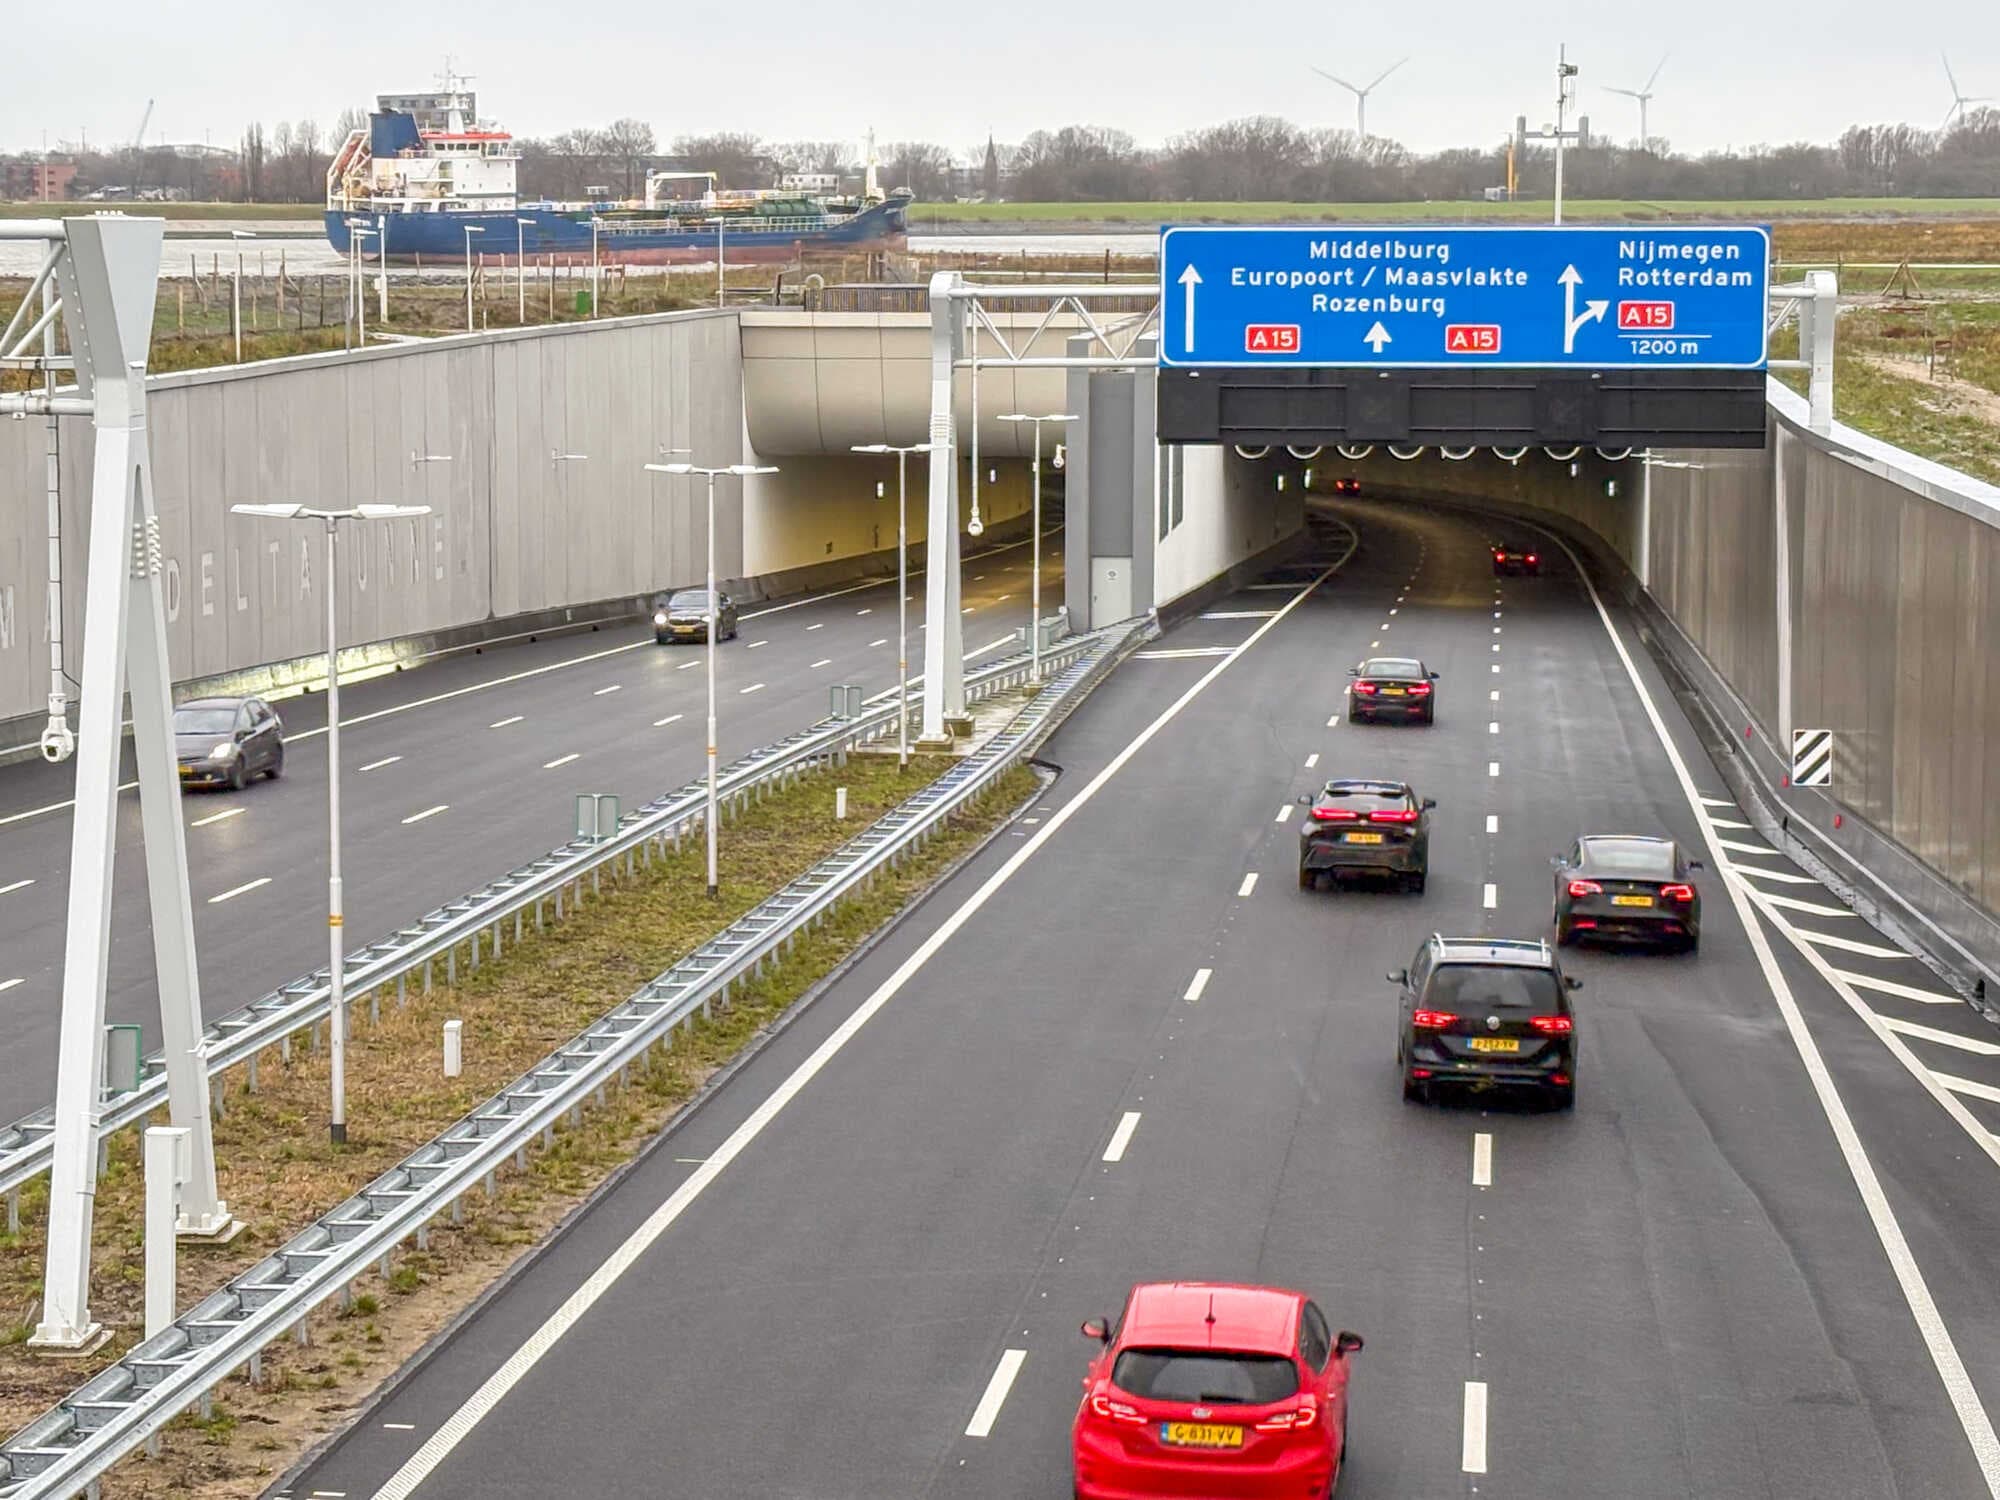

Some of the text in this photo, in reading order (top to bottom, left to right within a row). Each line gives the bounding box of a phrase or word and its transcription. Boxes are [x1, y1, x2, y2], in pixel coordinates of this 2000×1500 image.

[1310, 240, 1450, 264] Middelburg
[1619, 240, 1739, 265] Nijmegen
[1231, 265, 1528, 289] Europoort / Maasvlakte
[1618, 267, 1752, 286] Rotterdam
[1312, 293, 1445, 318] Rozenburg
[1624, 307, 1668, 324] A15
[1252, 330, 1294, 348] A15
[1452, 330, 1495, 348] A15
[1630, 340, 1698, 355] 1200 m
